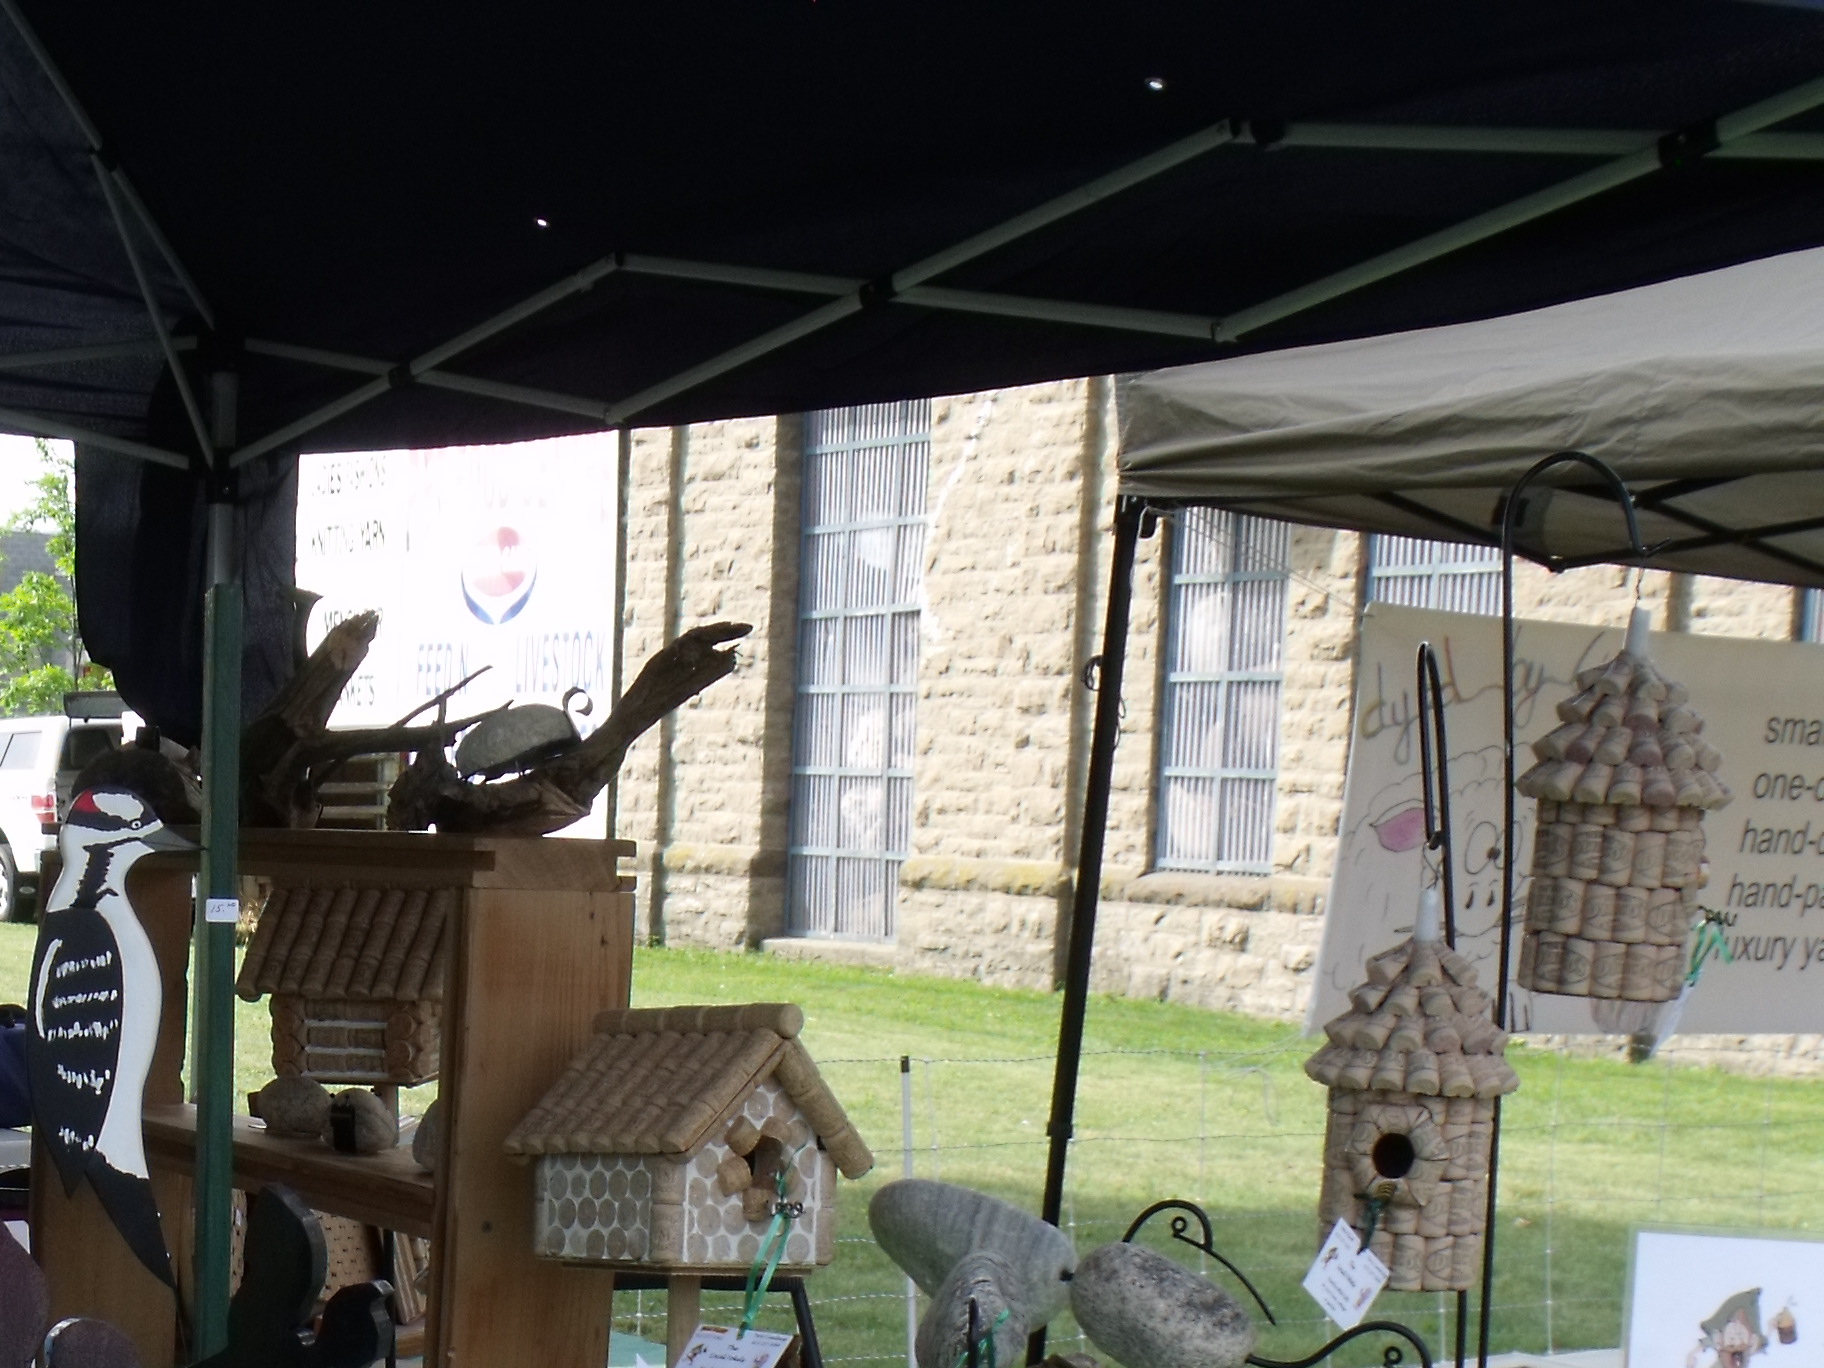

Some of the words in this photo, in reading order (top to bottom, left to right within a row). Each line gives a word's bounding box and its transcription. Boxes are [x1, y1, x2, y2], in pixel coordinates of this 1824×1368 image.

[360, 519, 386, 552] YARN
[416, 642, 455, 697] FEED
[515, 630, 606, 694] LIVESTOCK
[1765, 716, 1824, 747] sma
